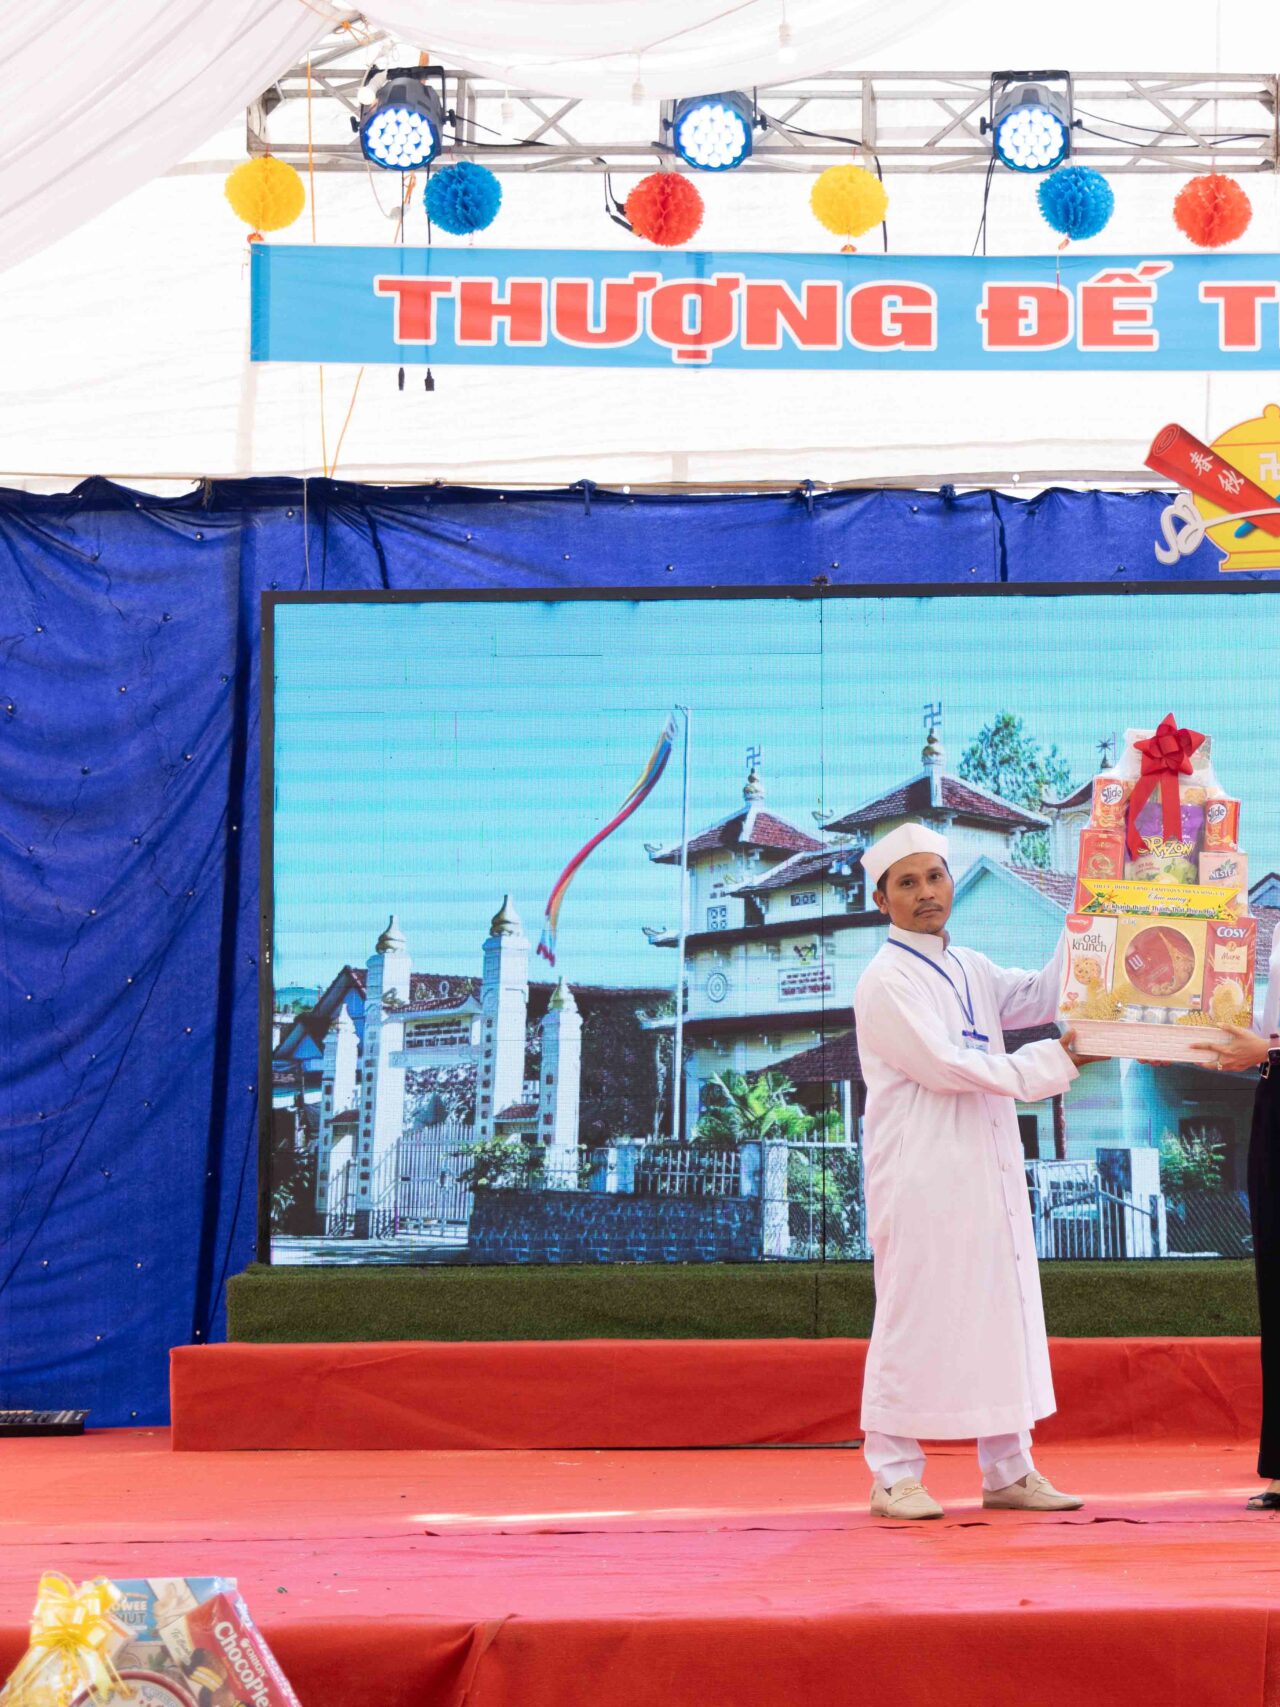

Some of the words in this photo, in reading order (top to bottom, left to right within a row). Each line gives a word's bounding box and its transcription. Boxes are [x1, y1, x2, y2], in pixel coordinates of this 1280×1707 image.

[375, 274, 936, 362] THƯỢNG
[978, 260, 1168, 350] ĐẾ
[1189, 450, 1245, 495] 春秋
[1072, 938, 1107, 952] krunch
[1083, 934, 1103, 944] oat
[1216, 926, 1247, 938] COSY
[213, 1620, 271, 1707] ChocoPie
